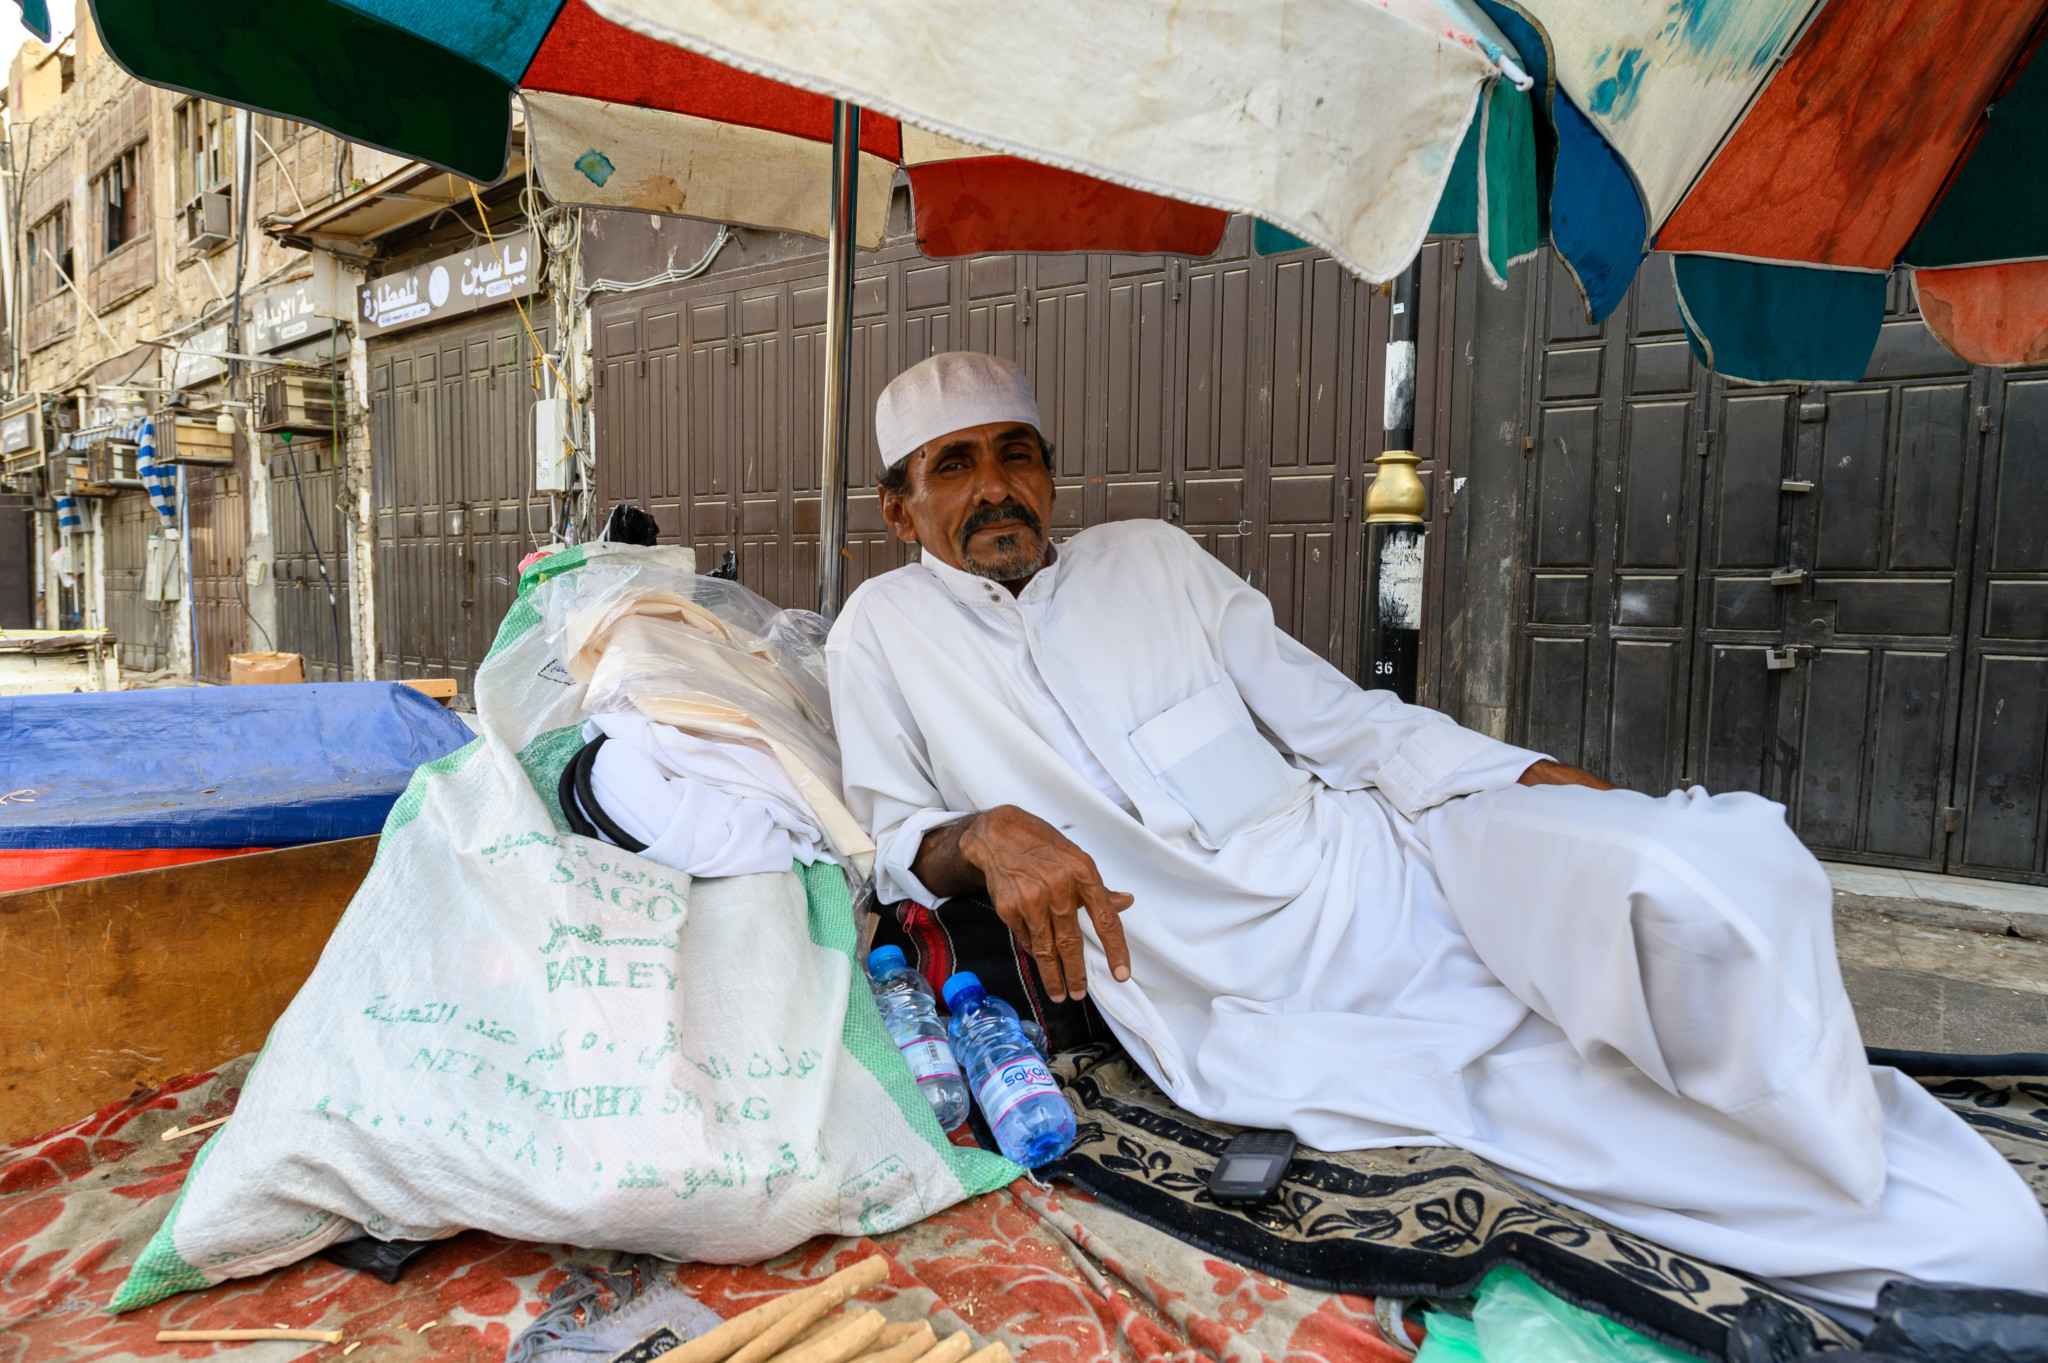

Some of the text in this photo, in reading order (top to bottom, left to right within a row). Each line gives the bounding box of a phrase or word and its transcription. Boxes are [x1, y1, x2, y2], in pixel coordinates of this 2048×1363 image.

[460, 244, 527, 296] ياسين
[362, 276, 419, 322] للعطارة
[1375, 661, 1393, 675] 36
[550, 856, 682, 922] SAGO
[406, 1047, 496, 1081] NET
[504, 1072, 648, 1121] WEIGHT
[714, 1096, 771, 1125] KG
